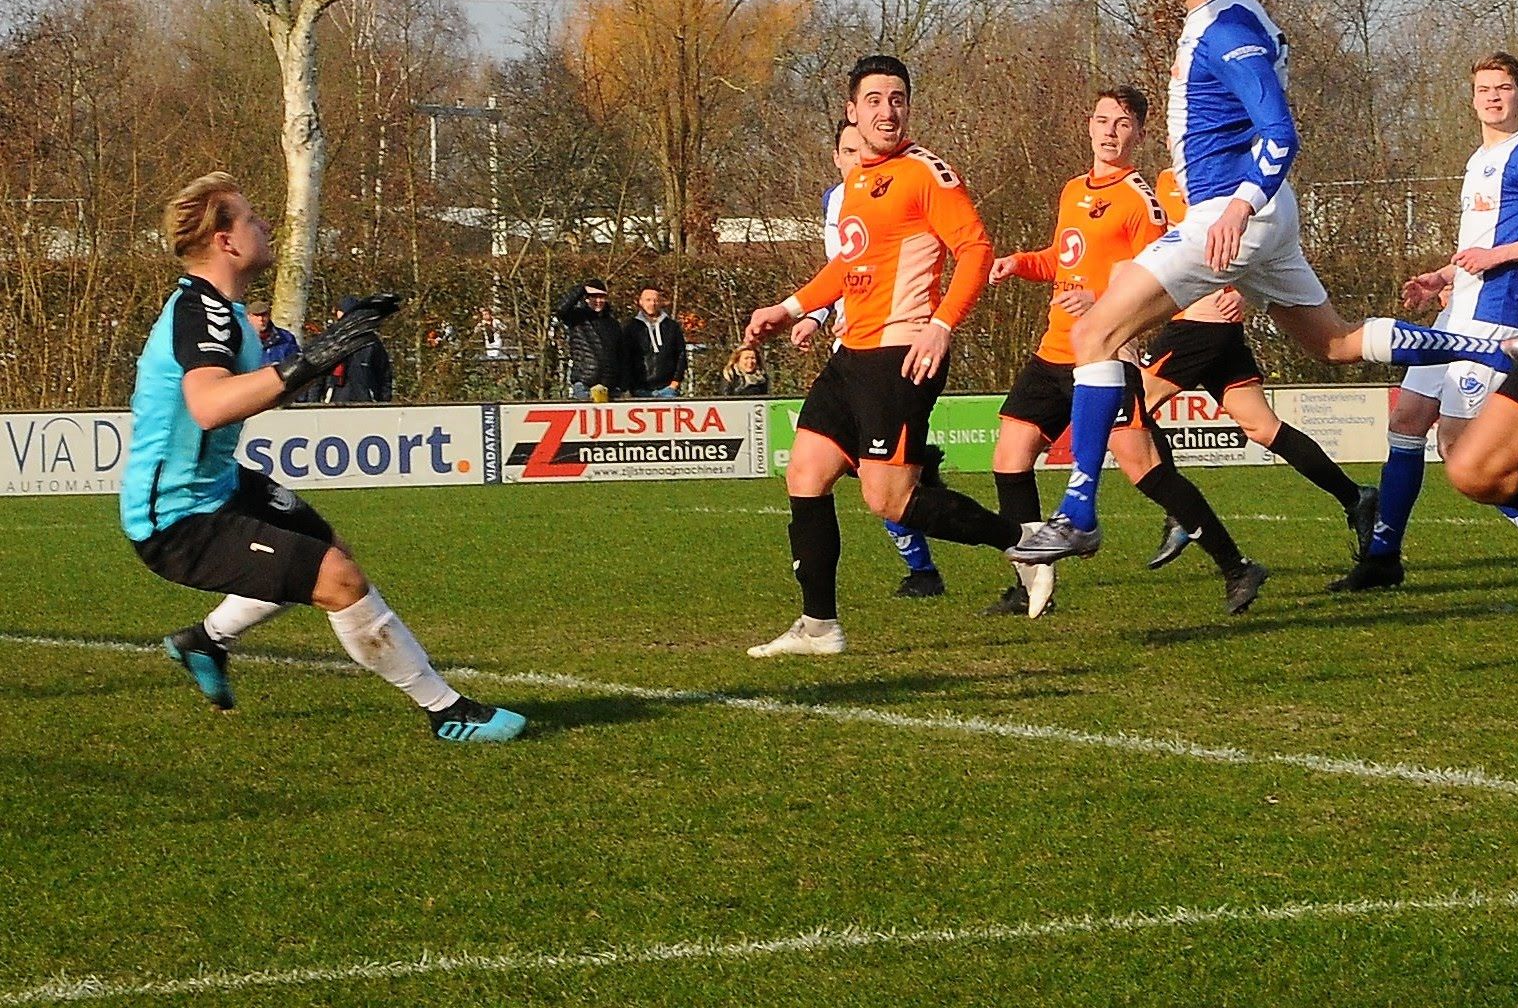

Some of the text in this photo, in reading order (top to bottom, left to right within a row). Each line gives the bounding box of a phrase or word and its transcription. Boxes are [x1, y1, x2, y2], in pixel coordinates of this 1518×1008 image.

[245, 426, 471, 478] scoort.
[484, 407, 497, 482] VIADATA.NL
[521, 407, 726, 478] ZIJLSTRA
[579, 440, 729, 463] naaimachines
[926, 430, 945, 445] AR
[949, 429, 986, 443] SINCE
